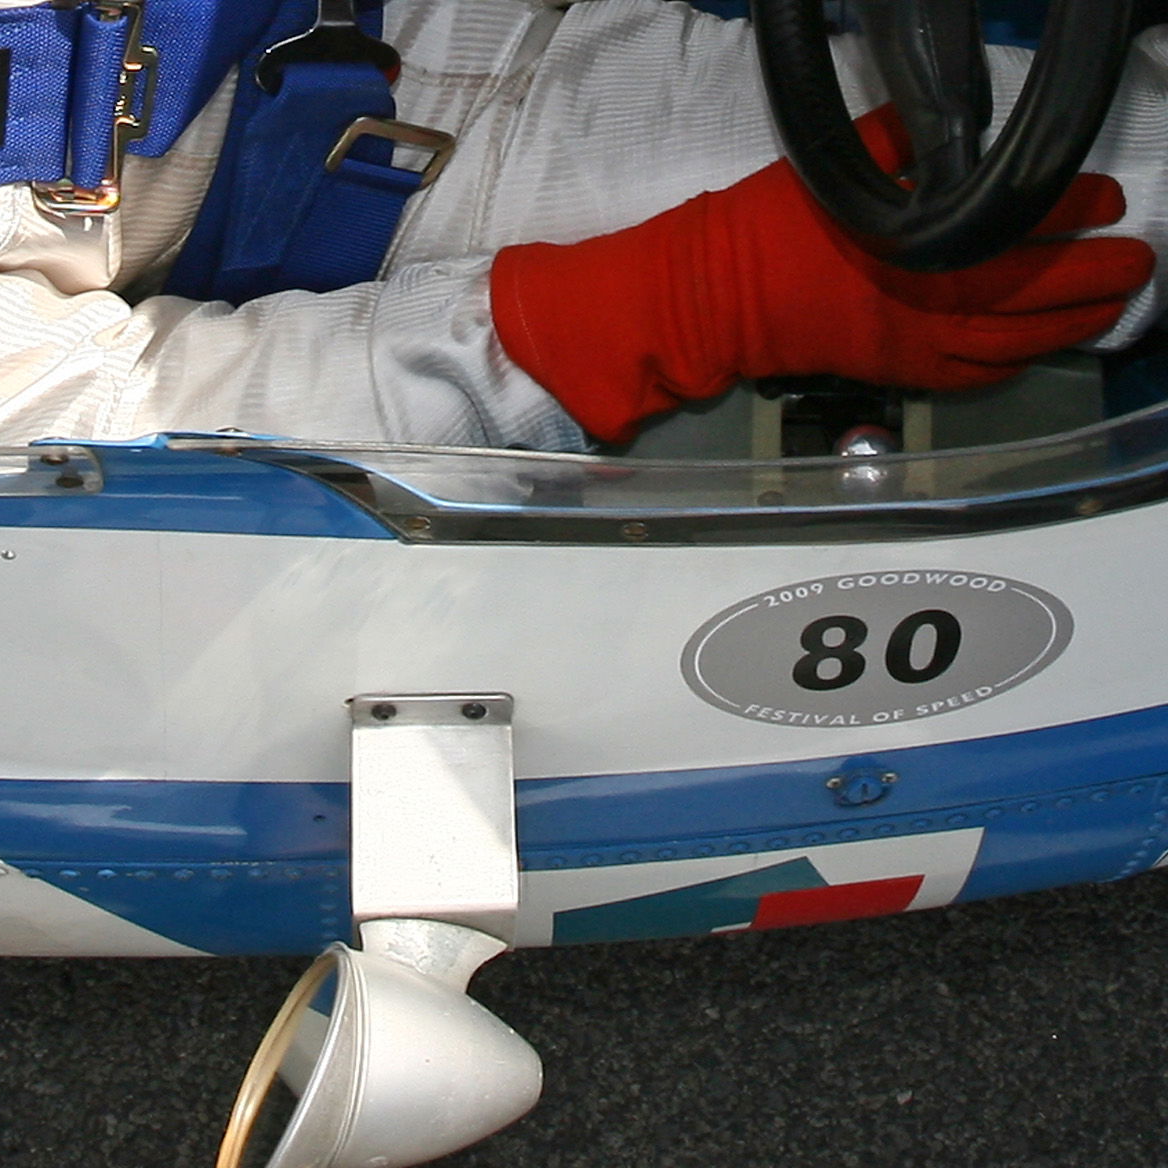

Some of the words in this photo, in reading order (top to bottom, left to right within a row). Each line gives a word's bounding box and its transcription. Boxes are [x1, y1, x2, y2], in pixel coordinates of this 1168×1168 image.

[764, 582, 824, 607] 2009
[836, 571, 1007, 593] GOODWOOD
[791, 608, 962, 692] 80
[744, 703, 861, 726] FESTIVAL
[873, 708, 904, 724] OF
[915, 684, 995, 716] SPEED
